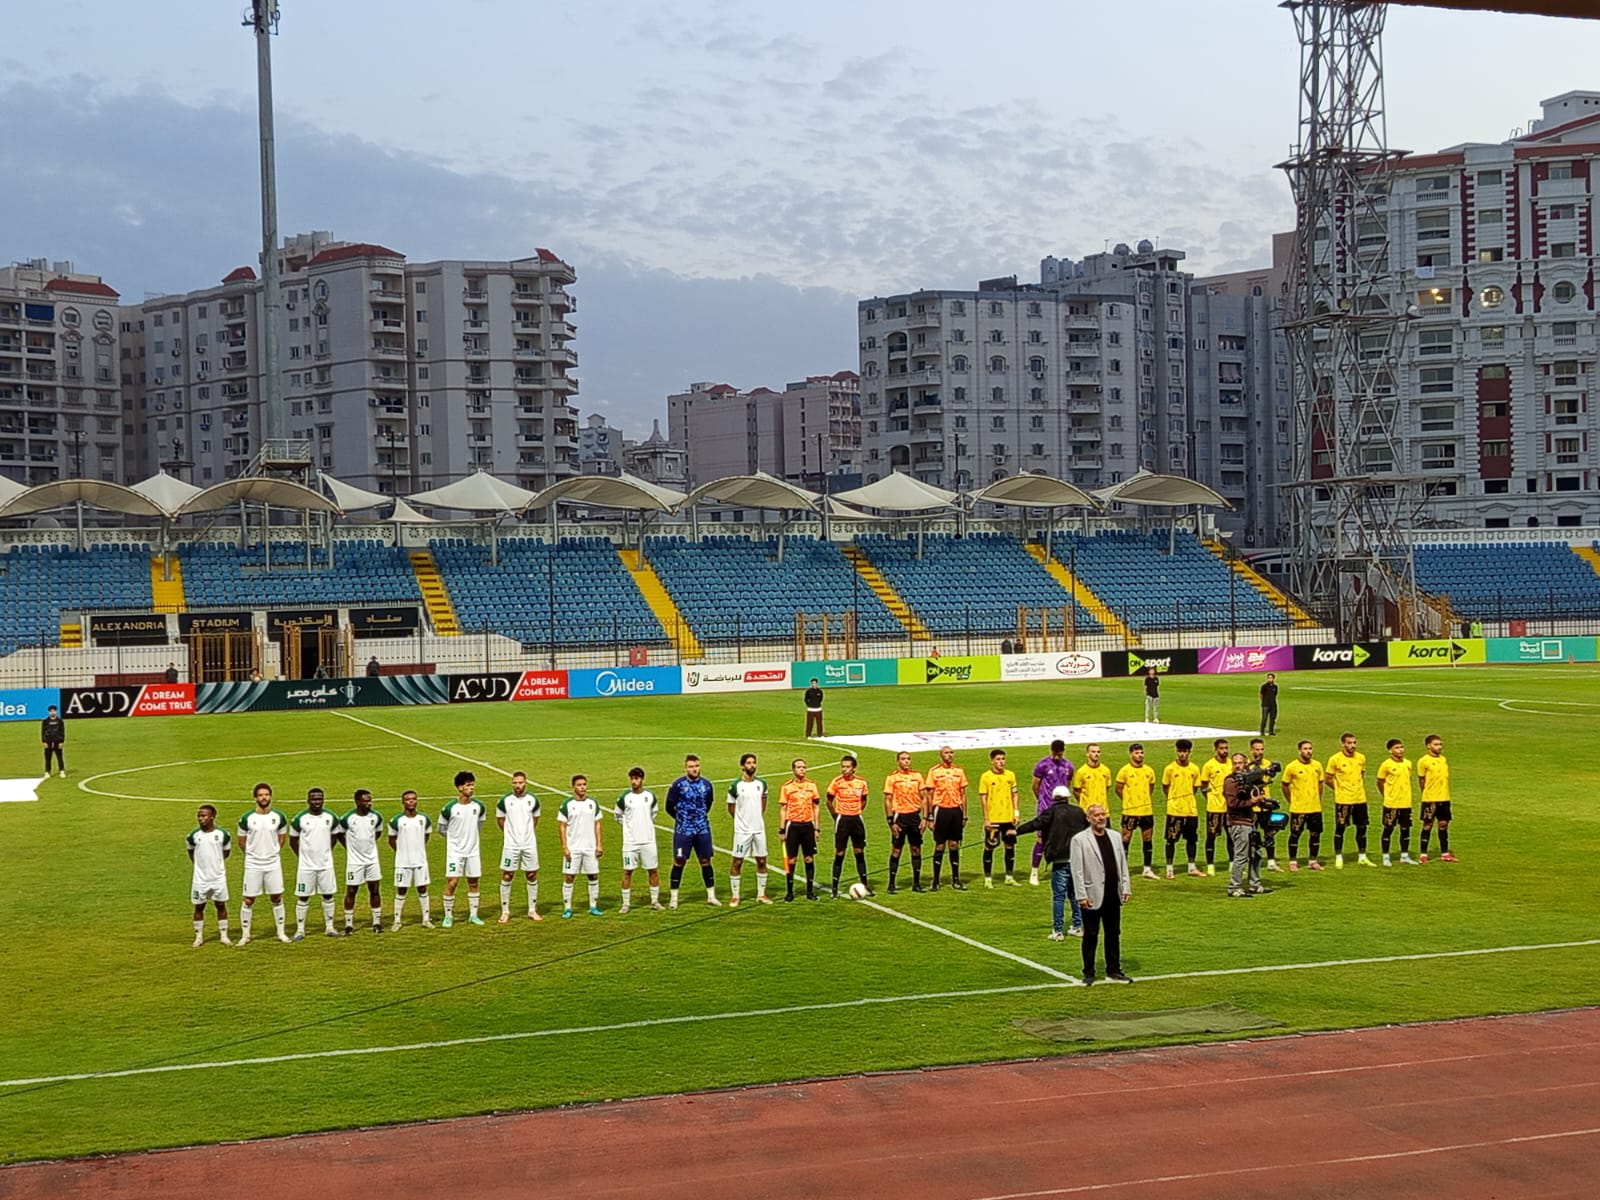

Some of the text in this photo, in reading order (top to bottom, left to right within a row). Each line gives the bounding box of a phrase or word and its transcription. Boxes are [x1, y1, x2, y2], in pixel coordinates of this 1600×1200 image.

[92, 621, 165, 631] ALEXANDRIA
[192, 618, 240, 629] STADIUM
[1312, 648, 1352, 661] kora
[1408, 645, 1448, 658] kora
[1144, 657, 1171, 668] sport
[944, 664, 972, 677] sport
[522, 677, 559, 687] A DREAM
[600, 675, 654, 693] Midea
[152, 691, 185, 700] DREAM
[519, 687, 566, 697] COME TRUE
[139, 701, 193, 712] COME TRUE
[449, 863, 456, 872] 5
